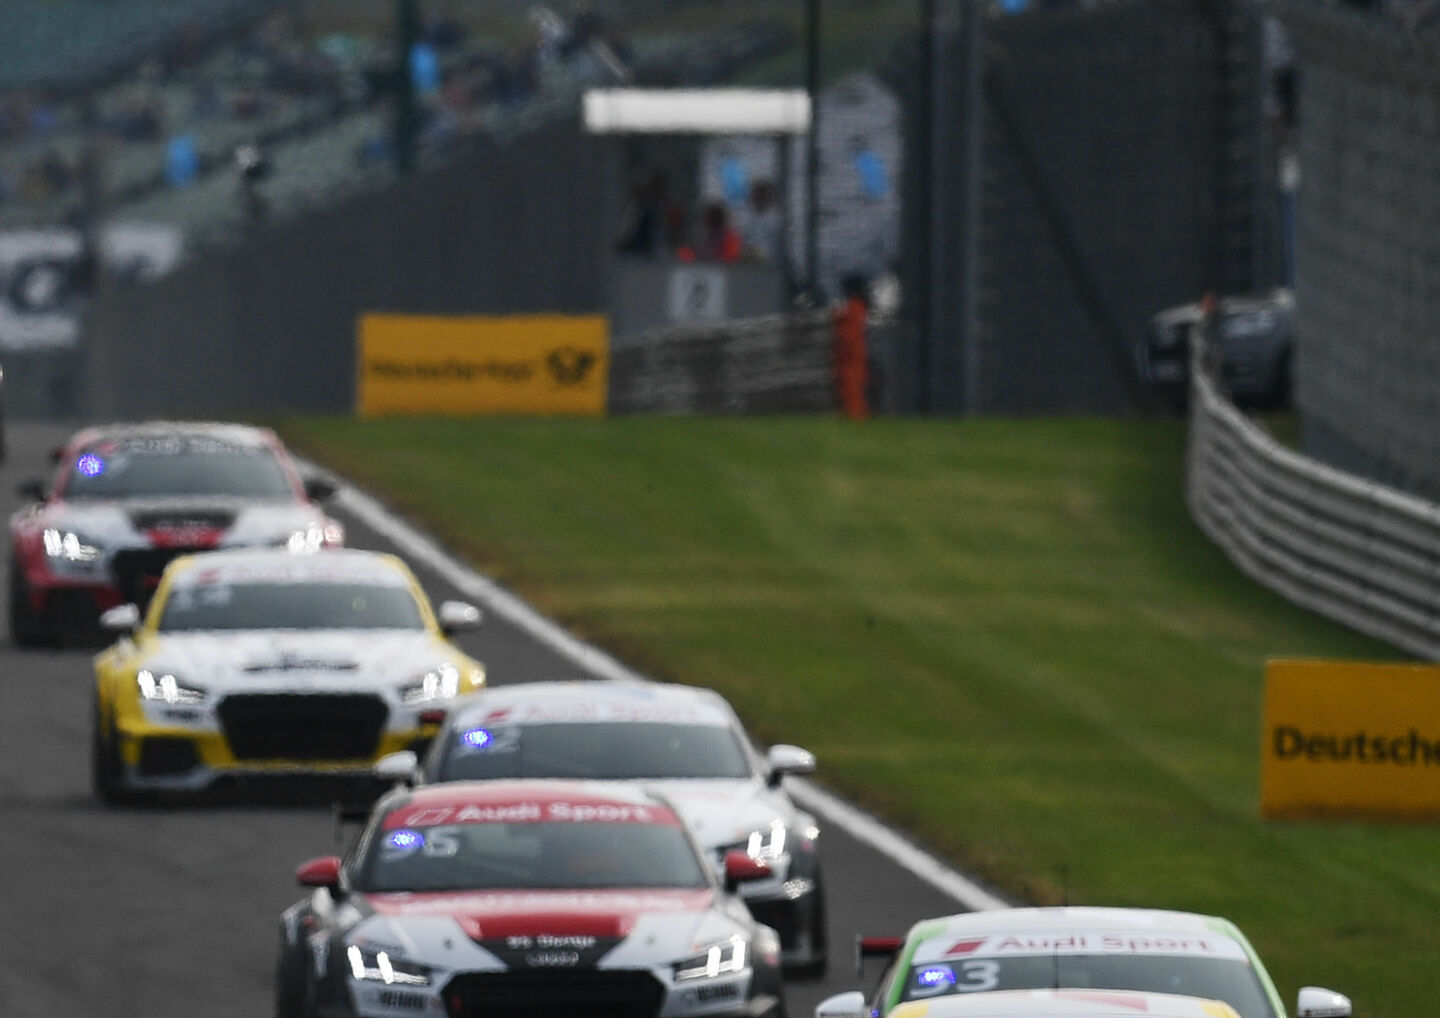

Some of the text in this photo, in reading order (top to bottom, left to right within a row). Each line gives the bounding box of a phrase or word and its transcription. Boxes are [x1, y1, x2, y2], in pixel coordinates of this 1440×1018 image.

[456, 802, 653, 822] Audi Sport
[997, 934, 1214, 952] Audi Sport
